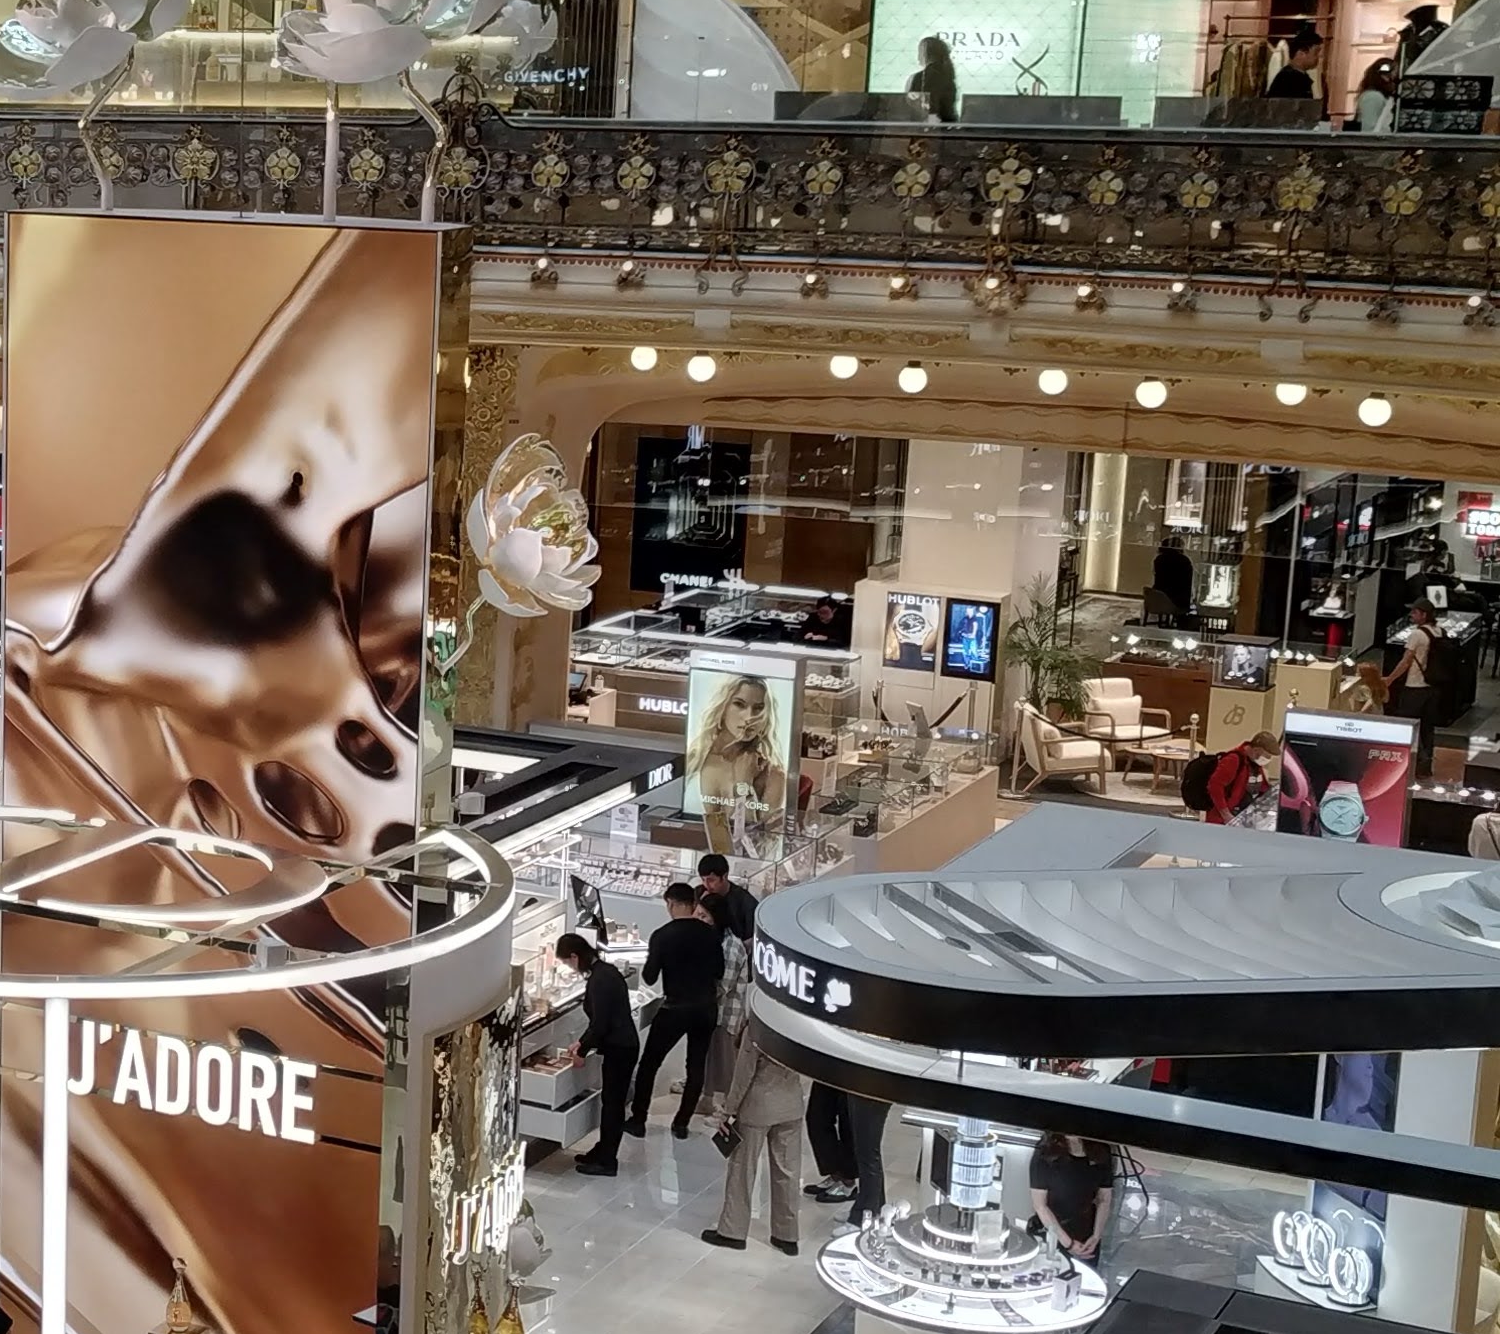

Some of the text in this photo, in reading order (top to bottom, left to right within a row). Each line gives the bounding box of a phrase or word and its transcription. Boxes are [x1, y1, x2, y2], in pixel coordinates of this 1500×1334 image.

[504, 67, 590, 83] GIVENCHY
[887, 593, 940, 606] HUBLOT
[648, 763, 674, 790] DIOR
[744, 801, 770, 812] KORS
[69, 1019, 318, 1145] J'ADORE
